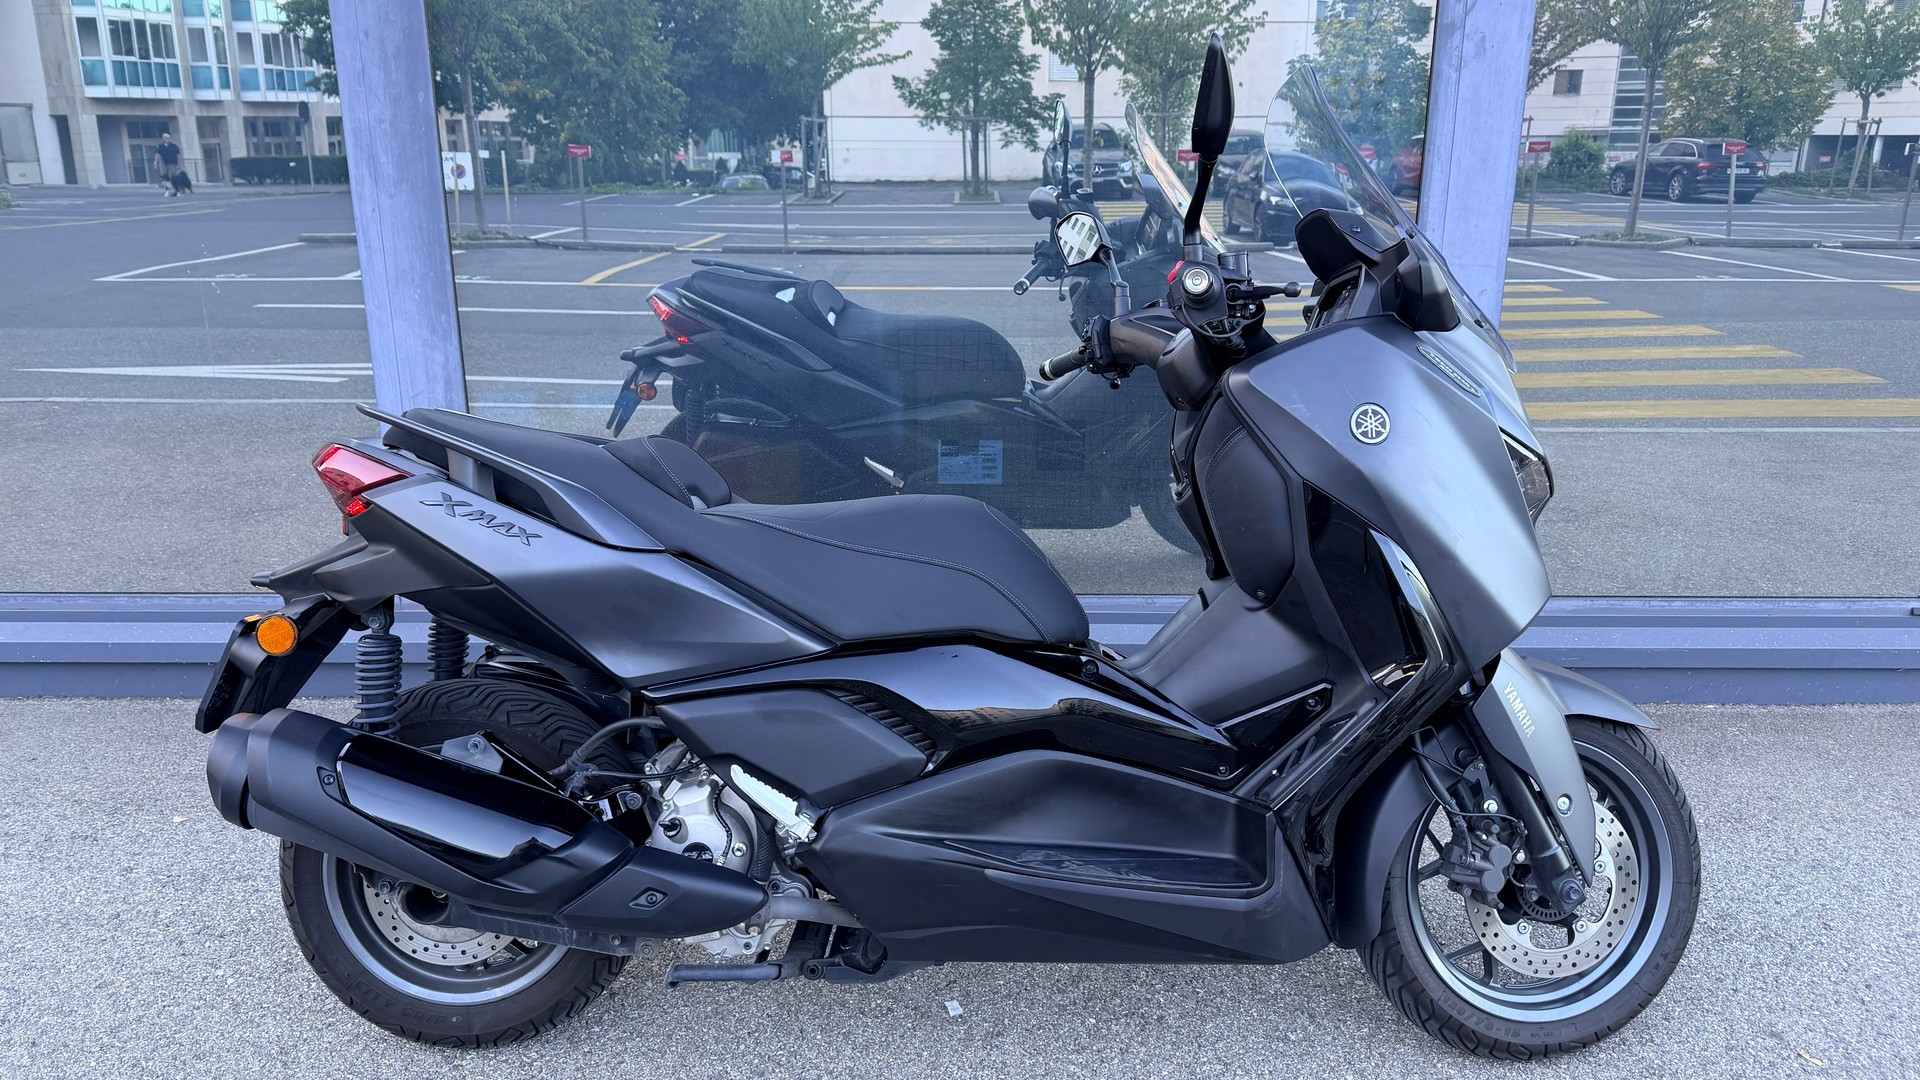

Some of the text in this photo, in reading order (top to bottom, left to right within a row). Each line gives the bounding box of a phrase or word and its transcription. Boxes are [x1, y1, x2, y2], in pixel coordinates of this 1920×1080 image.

[1503, 681, 1536, 738] YAMAHA
[356, 980, 448, 1025] CITY GRIP
